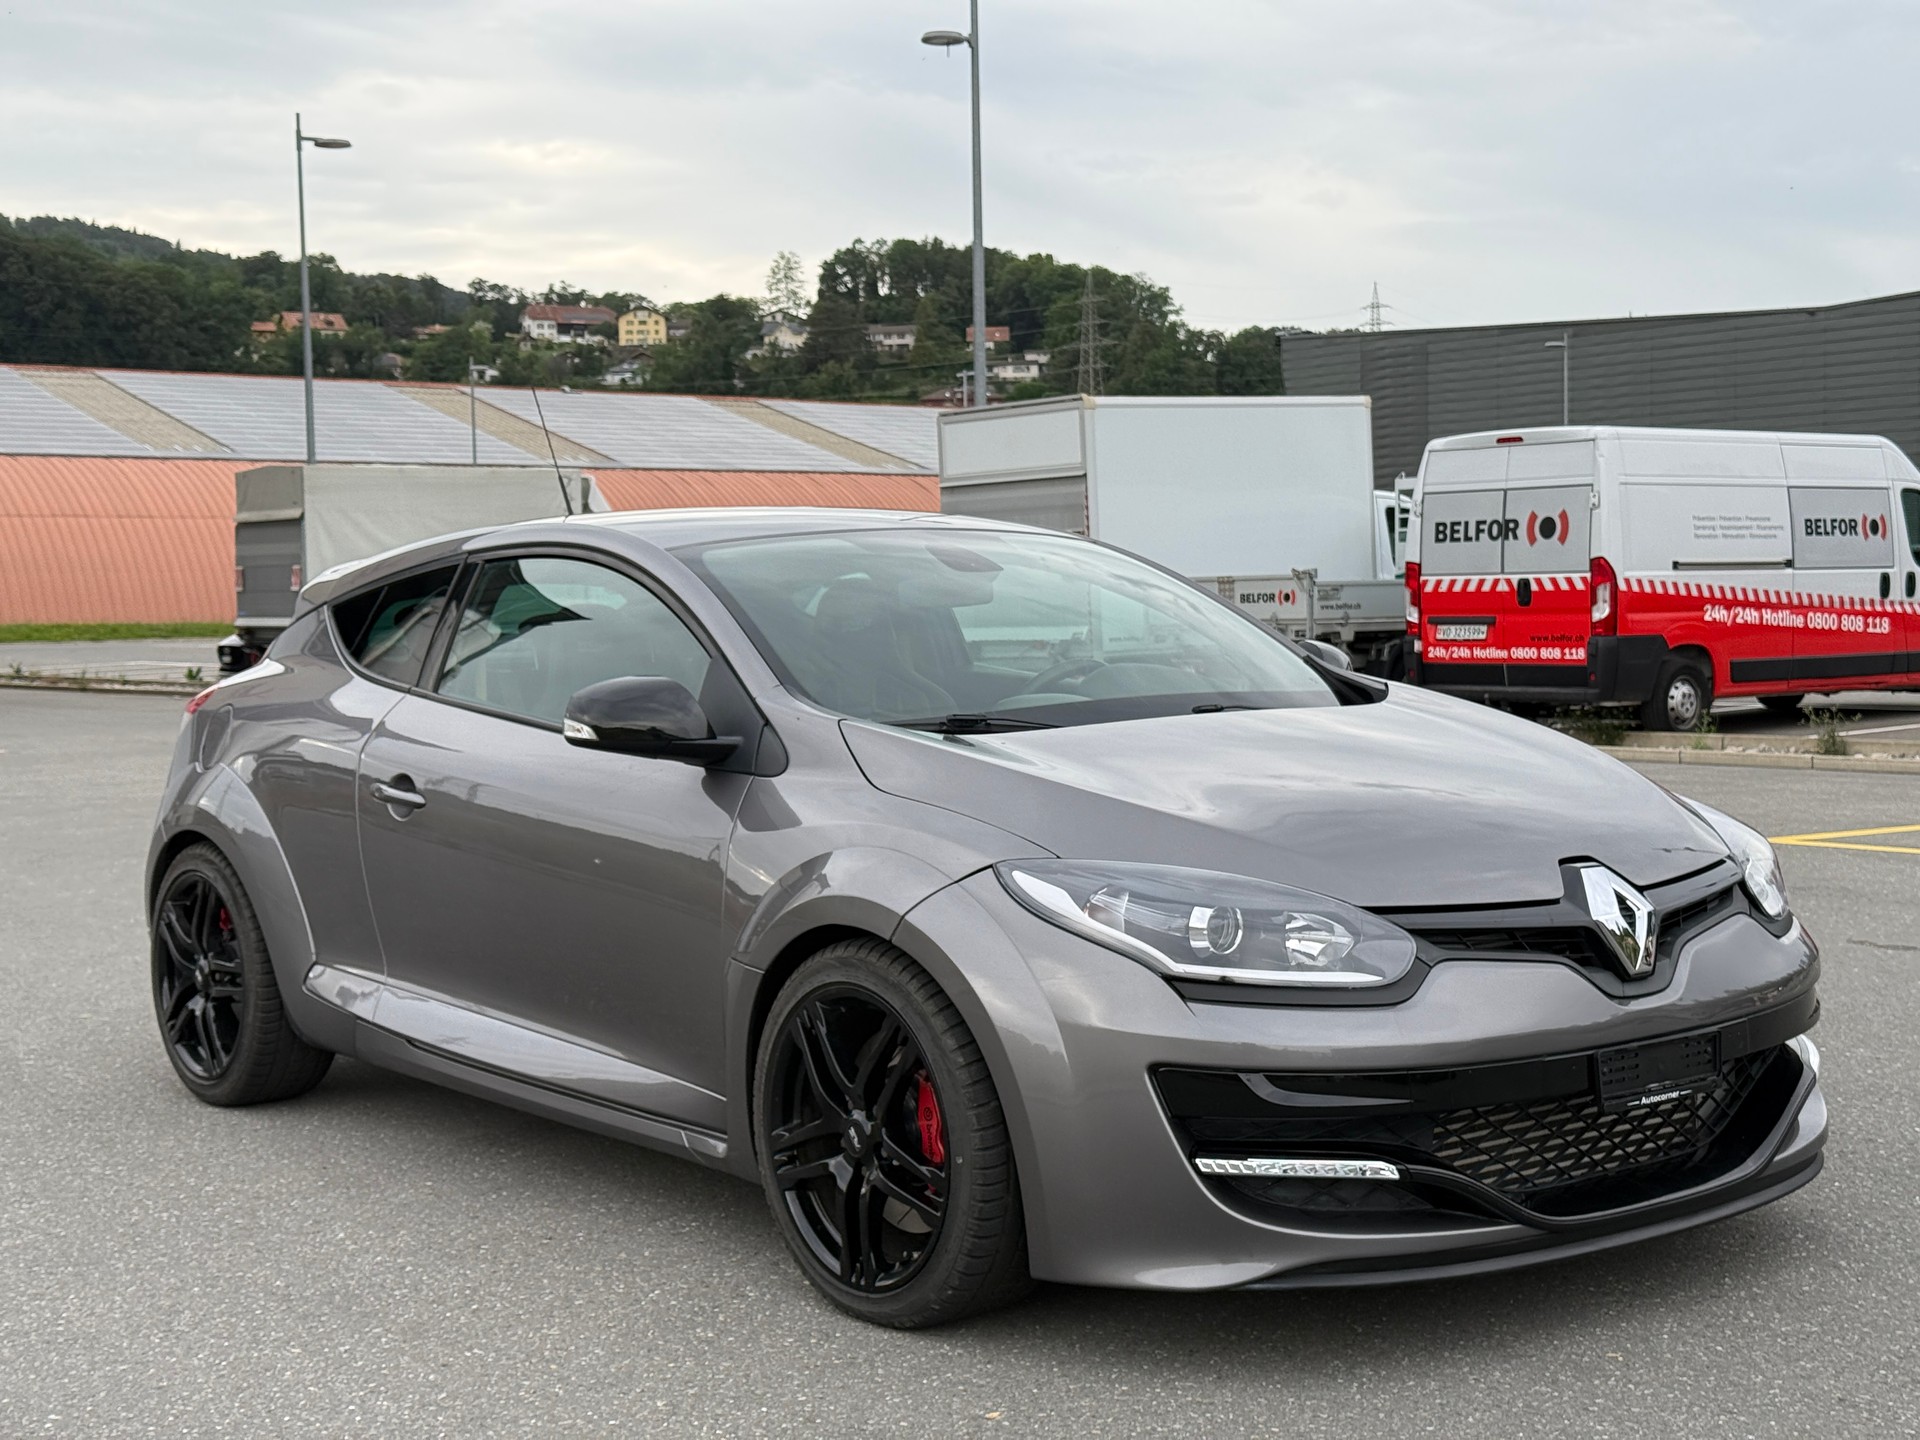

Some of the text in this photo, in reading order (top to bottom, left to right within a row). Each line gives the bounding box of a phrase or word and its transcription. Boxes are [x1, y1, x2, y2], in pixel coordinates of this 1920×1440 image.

[1434, 518, 1520, 544] BELFOR
[1803, 518, 1859, 537] BELFOR
[1239, 592, 1276, 604] BELFOR
[1703, 603, 1891, 635] 24h/24h Hotline 0800 808 118
[1530, 633, 1585, 643] www.belfor.ch
[1427, 646, 1586, 660] 24h/24h Hotline 0800 808 118
[1640, 1090, 1680, 1106] Autocorner
[926, 1123, 935, 1160] bremb
